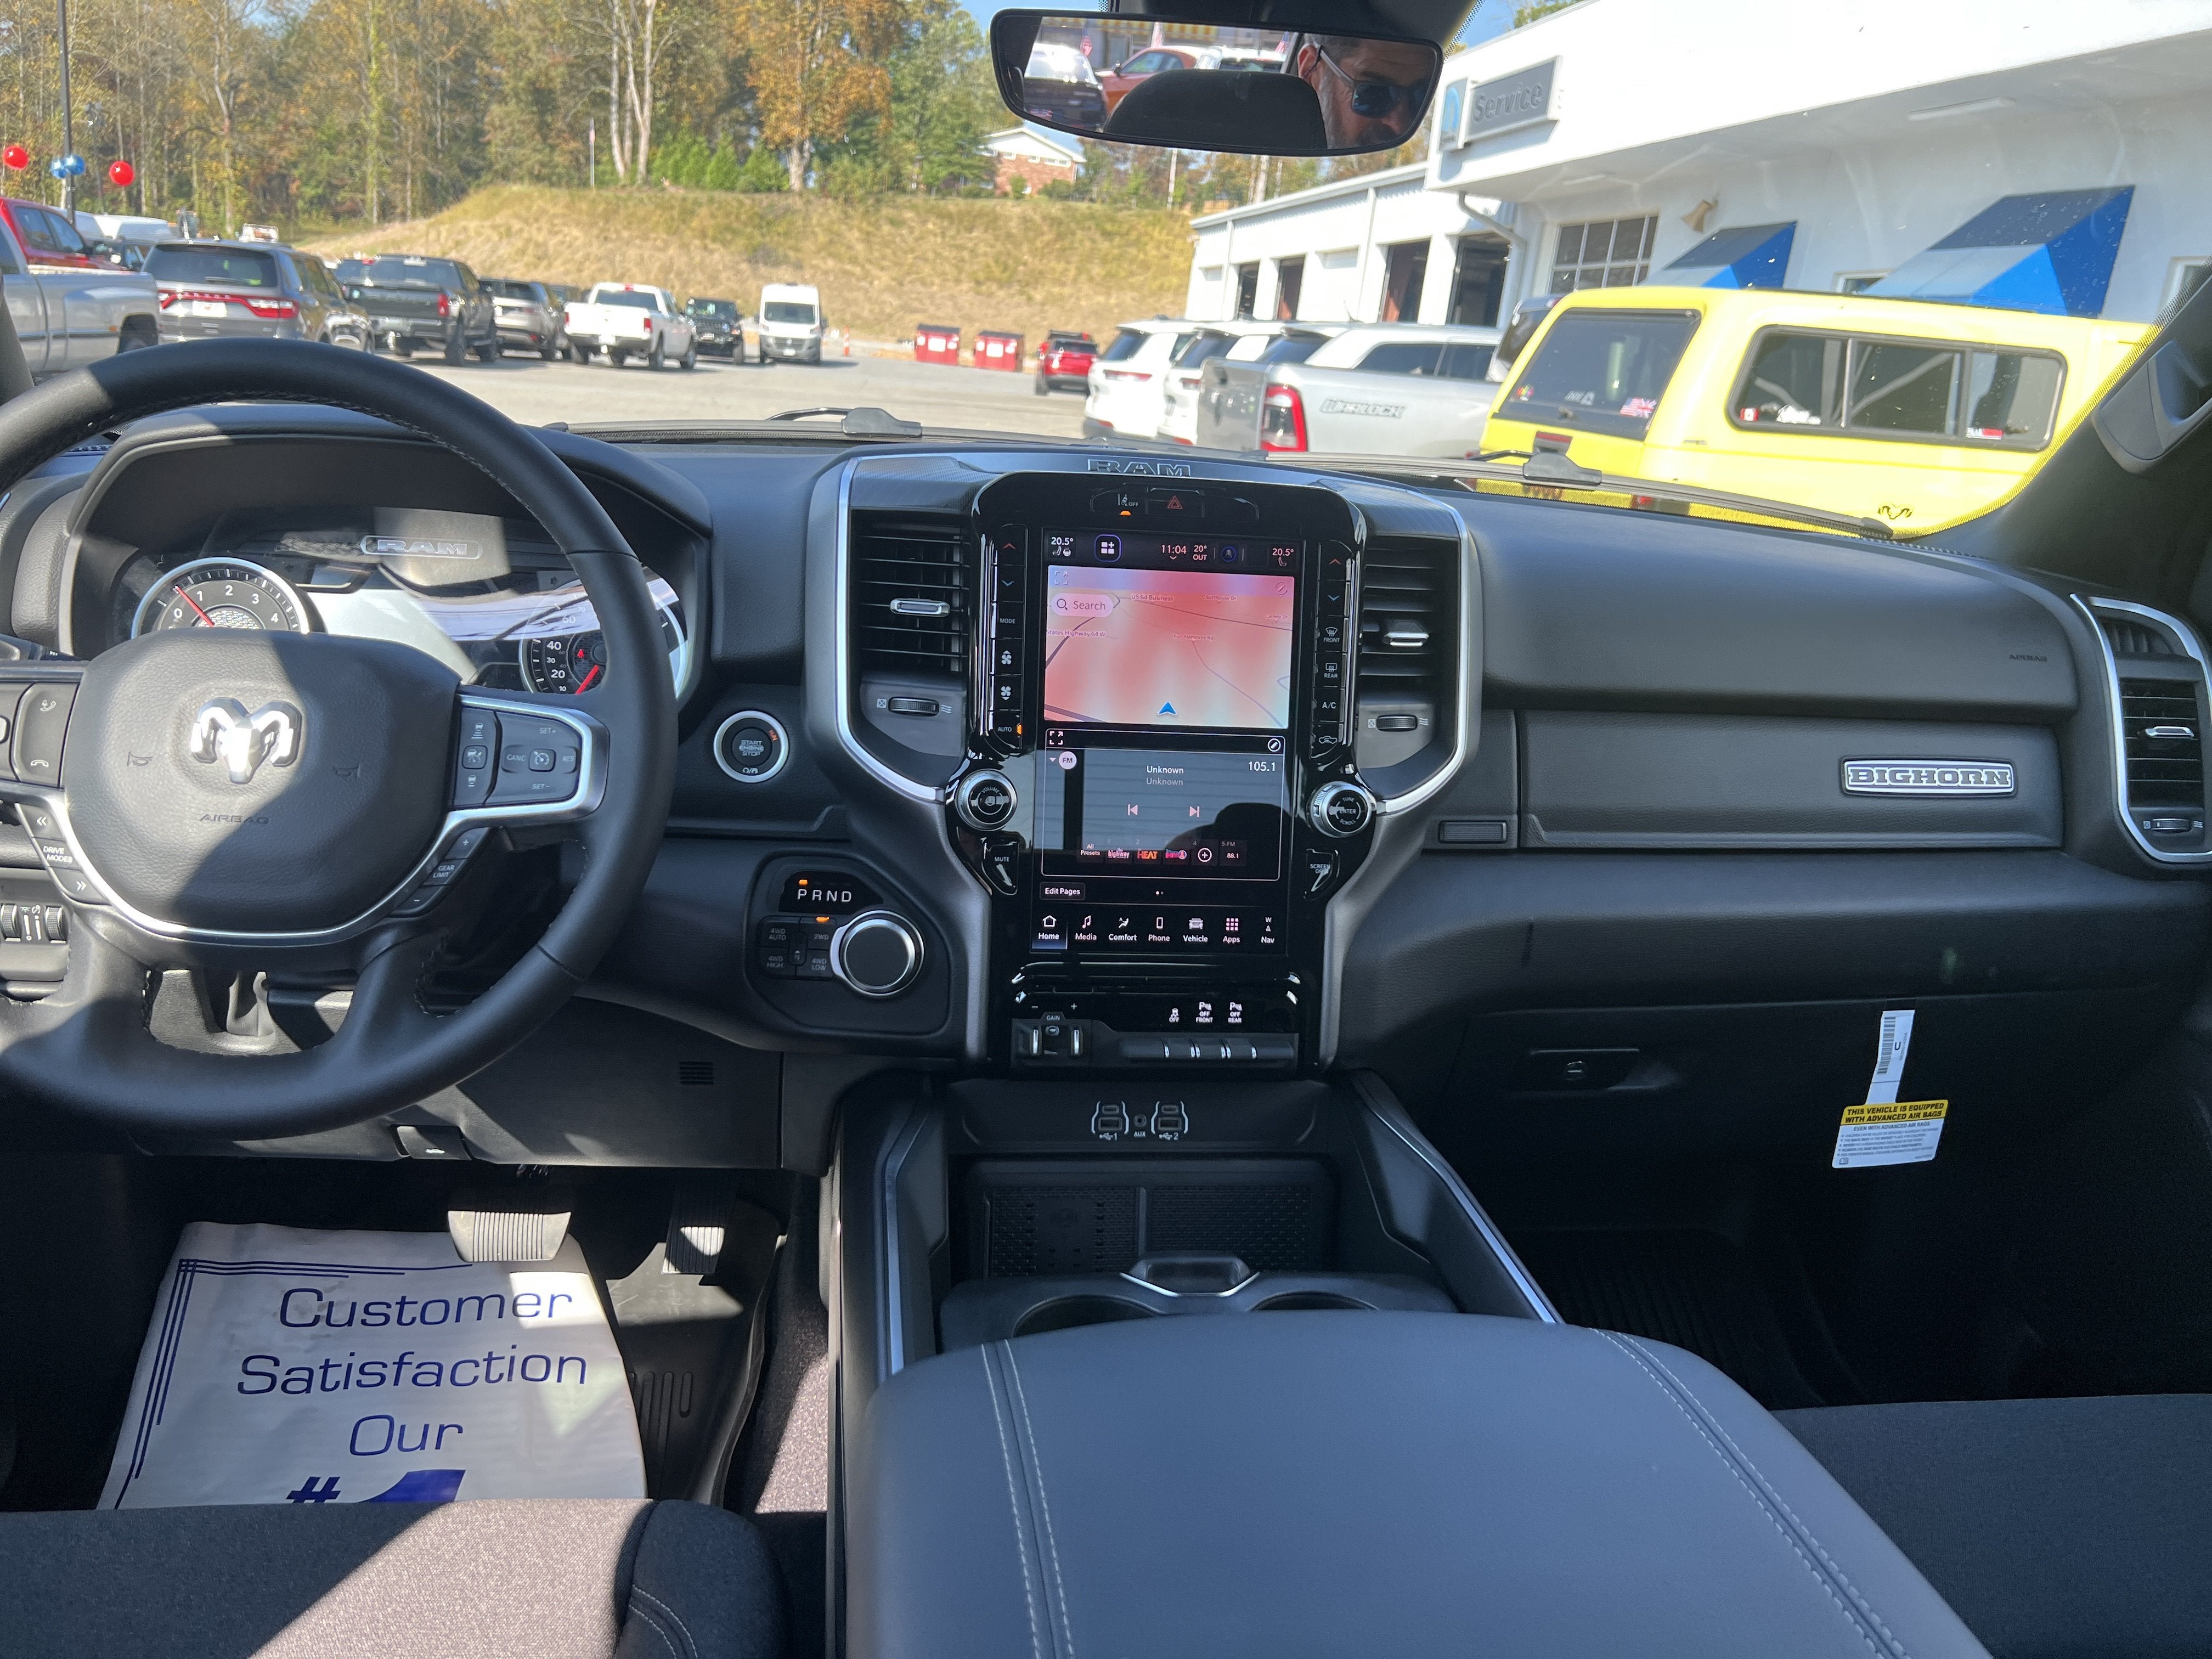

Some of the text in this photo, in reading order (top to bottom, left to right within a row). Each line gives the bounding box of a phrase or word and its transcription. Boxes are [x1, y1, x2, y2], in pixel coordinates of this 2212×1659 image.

[1472, 82, 1543, 125] Service
[1087, 459, 1191, 477] RAM
[377, 539, 467, 555] RAM
[1161, 544, 1187, 554] 11:04
[196, 590, 203, 601] 1
[225, 585, 233, 596] 2
[251, 593, 259, 604] 3
[1073, 600, 1106, 611] Search
[174, 608, 183, 619] 0
[270, 613, 279, 623] 4
[562, 615, 576, 624] 60
[546, 641, 562, 651] 40
[551, 669, 566, 679] 20
[1147, 765, 1184, 775] Unknown
[1248, 761, 1276, 772] 105.1
[1147, 777, 1184, 786] Unknown
[1848, 767, 2011, 787] BIGHORN
[199, 814, 269, 825] AIRBAG
[43, 846, 65, 854] DRIVE
[1108, 850, 1130, 859] highway
[1137, 850, 1158, 859] HEAT
[47, 854, 73, 862] MODES
[1060, 888, 1080, 896] Pages
[1222, 936, 1240, 944] Apps
[1909, 1103, 1944, 1111] EQUIPPED
[1866, 1113, 1906, 1121] ADVANCED
[280, 1288, 572, 1329] Customer
[237, 1345, 588, 1395] Satisfaction
[349, 1414, 463, 1456] Our
